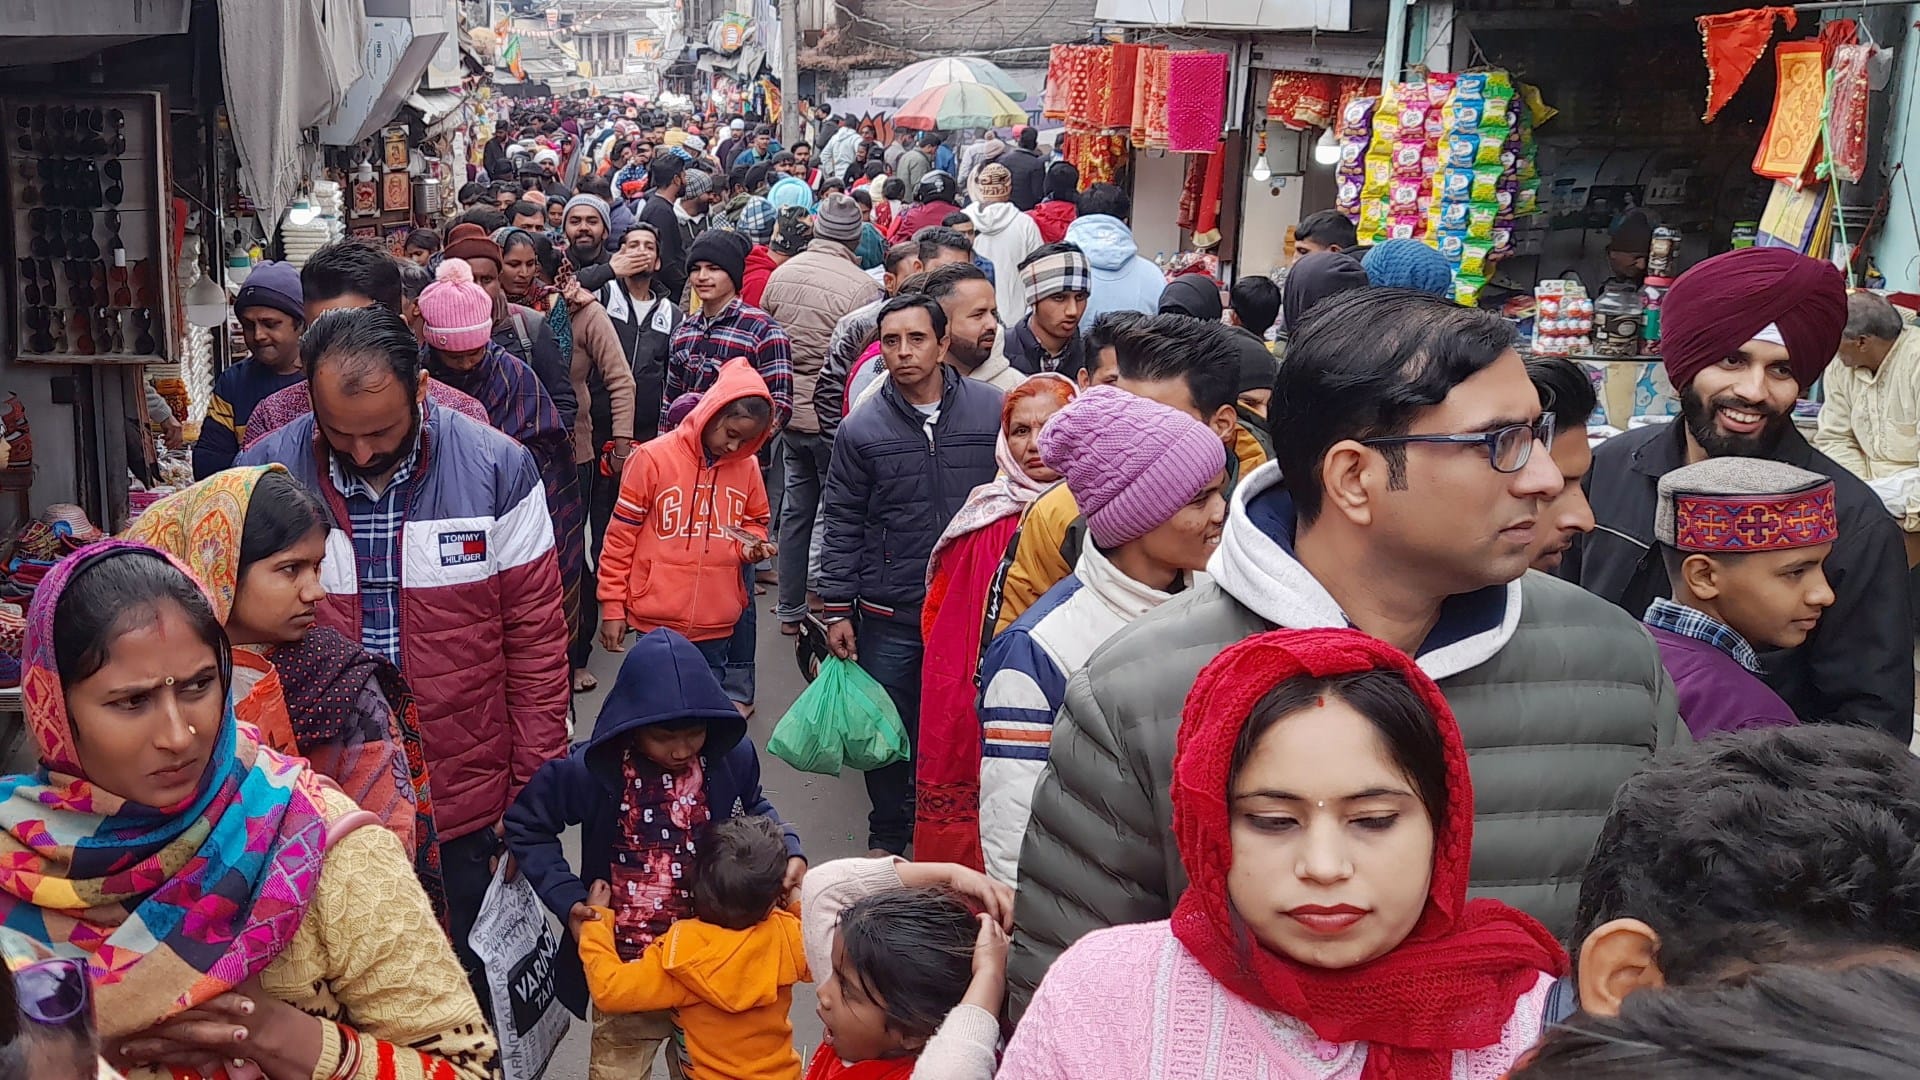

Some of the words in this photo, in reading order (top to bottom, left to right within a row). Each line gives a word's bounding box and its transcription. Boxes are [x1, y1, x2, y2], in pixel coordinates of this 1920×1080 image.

[656, 485, 748, 541] GAP
[444, 533, 480, 543] TOMMY
[445, 553, 481, 564] HILFIGER
